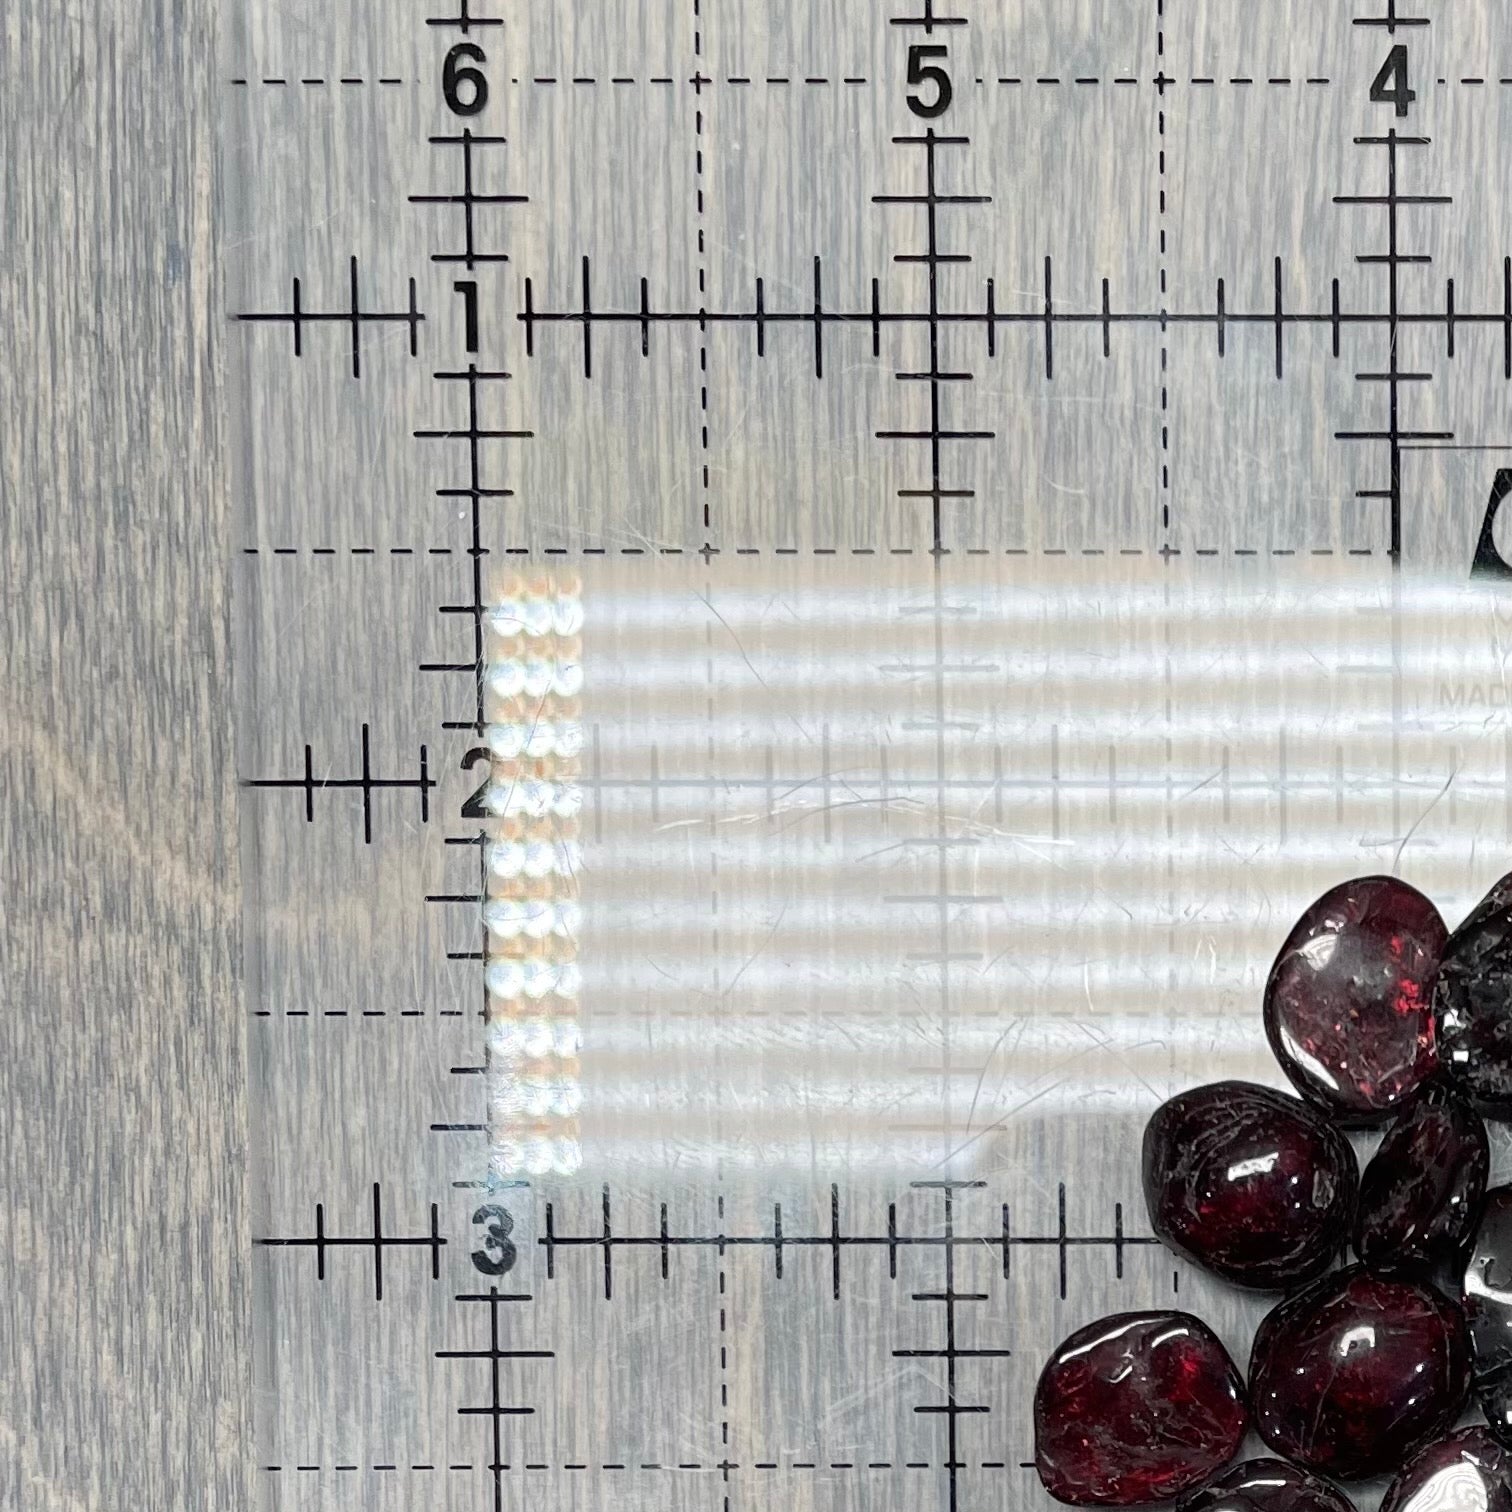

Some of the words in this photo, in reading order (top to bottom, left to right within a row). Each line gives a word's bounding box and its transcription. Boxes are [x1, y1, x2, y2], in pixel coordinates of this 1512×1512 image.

[443, 43, 488, 116] 6
[906, 45, 952, 118] 5
[1370, 45, 1415, 117] 4
[454, 281, 478, 353] 1
[471, 1206, 516, 1275] 3
